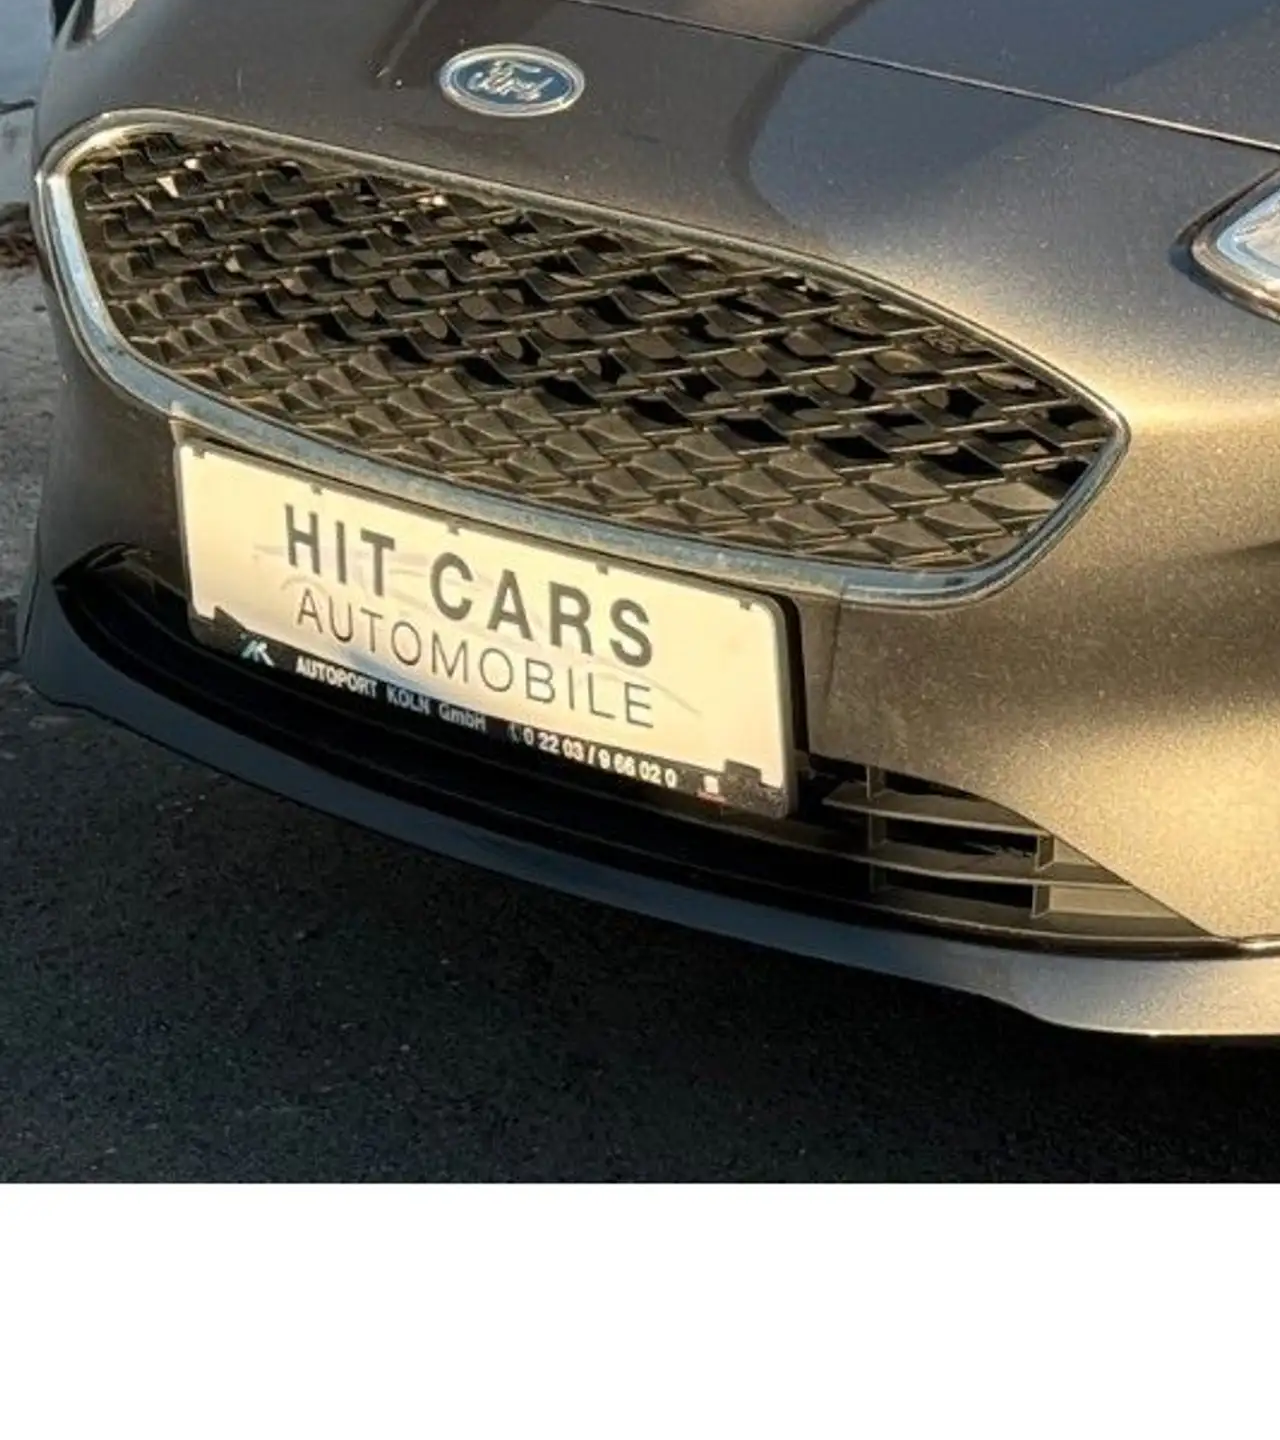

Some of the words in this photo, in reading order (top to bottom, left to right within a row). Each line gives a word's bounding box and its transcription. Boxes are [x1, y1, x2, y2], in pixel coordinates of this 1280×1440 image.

[284, 503, 396, 597] HIT
[430, 552, 654, 668] CARS
[295, 655, 378, 699] AUTOPORT
[438, 702, 487, 733] GmbH
[297, 588, 655, 729] AUTOMOBILE
